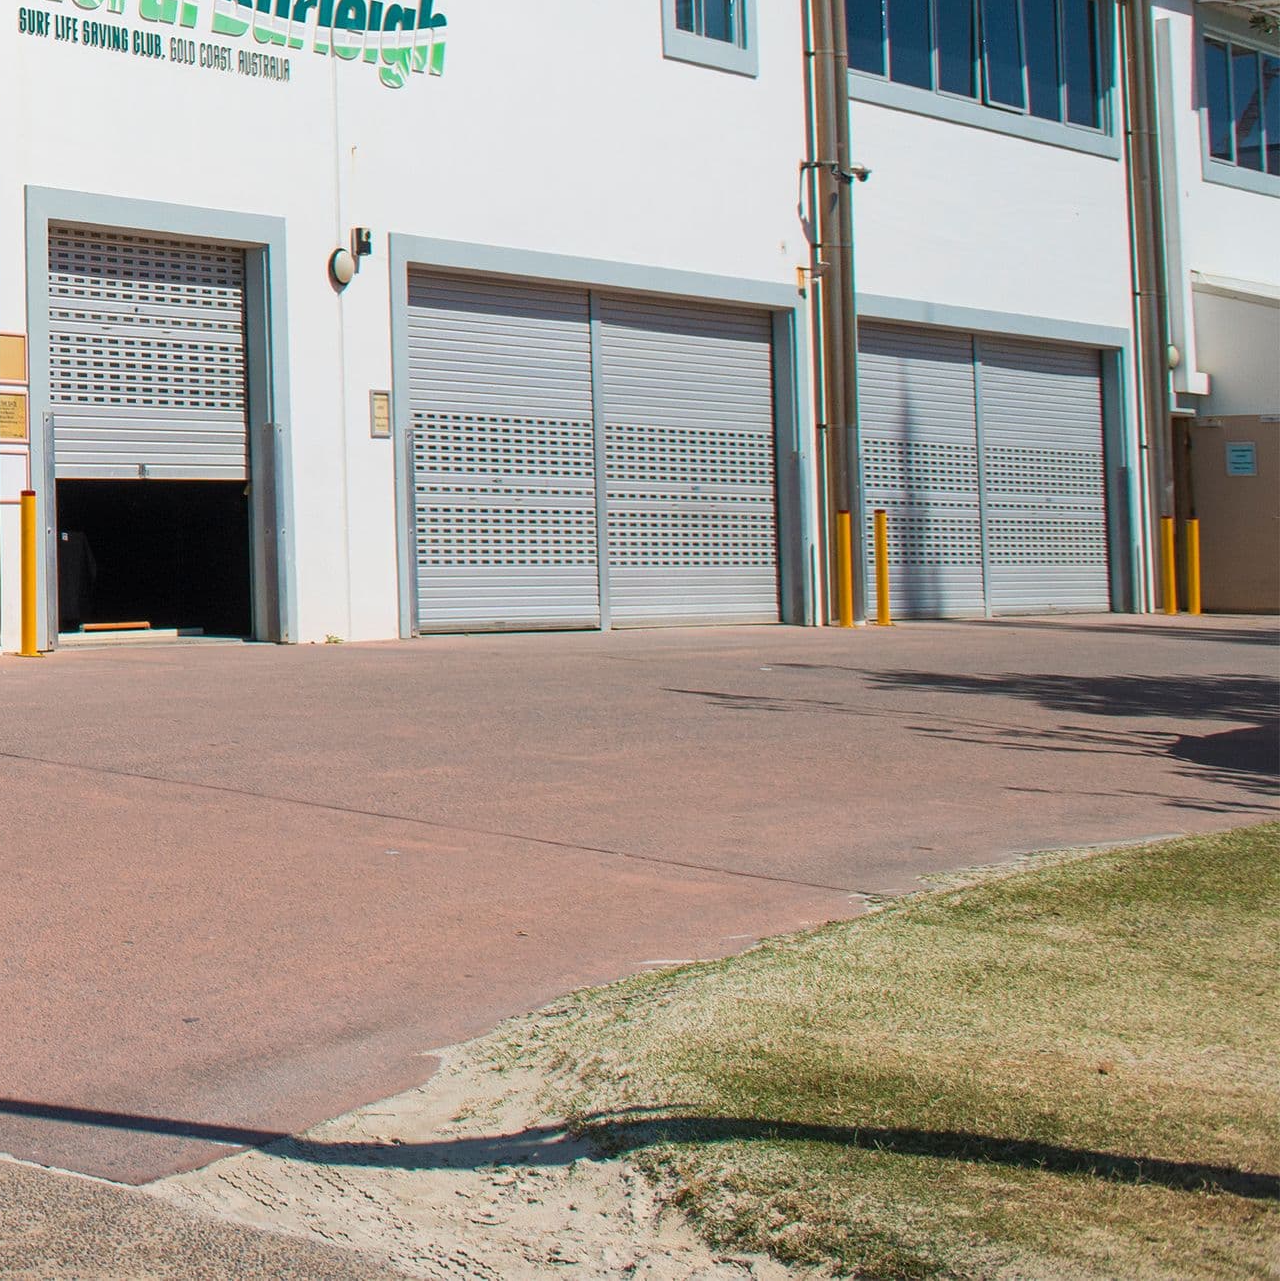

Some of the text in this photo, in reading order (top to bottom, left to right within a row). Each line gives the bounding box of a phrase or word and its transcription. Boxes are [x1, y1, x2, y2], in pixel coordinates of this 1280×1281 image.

[18, 7, 51, 38] SURF
[54, 14, 79, 44] LIFE
[81, 20, 129, 53] SAVING
[170, 36, 196, 66] GOLD
[237, 49, 290, 82] AUSTRALIA
